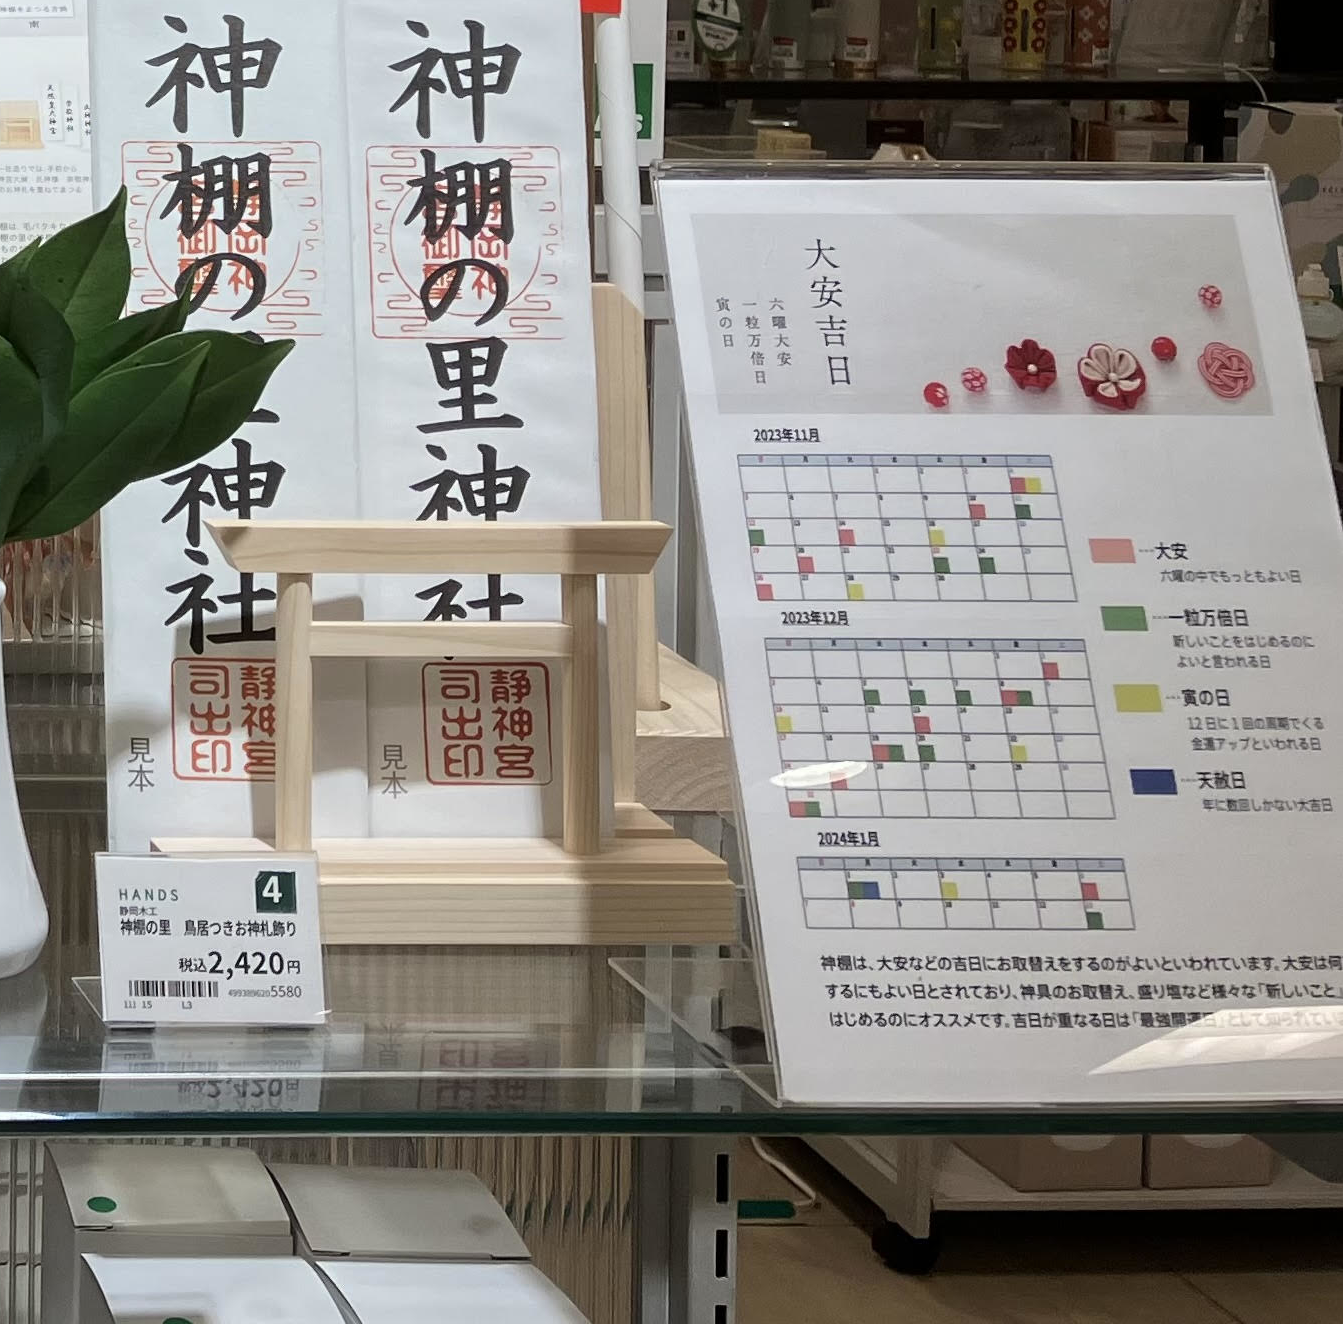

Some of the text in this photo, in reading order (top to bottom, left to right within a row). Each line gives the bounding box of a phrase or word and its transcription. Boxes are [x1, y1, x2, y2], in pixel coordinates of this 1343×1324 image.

[804, 238, 853, 386] 大安吉日
[715, 297, 735, 348] 寅の日
[769, 297, 793, 367] 六曜大安
[741, 301, 767, 385] 一粒万倍日
[753, 428, 821, 444] 2023年11月
[1155, 543, 1189, 561] 大安
[781, 610, 850, 627] 2023年12月
[1169, 609, 1249, 627] 一粒万倍日
[1172, 635, 1316, 649] 新しいことをはじめるのに
[1177, 655, 1272, 669] よいと言われる日
[1181, 689, 1231, 707] 寅の日
[127, 737, 155, 792] 見本
[381, 744, 408, 799] 見本
[817, 831, 881, 847] 2024年1月
[118, 888, 180, 902] HANDS
[262, 875, 283, 905] 4
[120, 918, 298, 938] 神棚の里 鳥居つきお神札飾り
[178, 950, 302, 981] 税込2,420円
